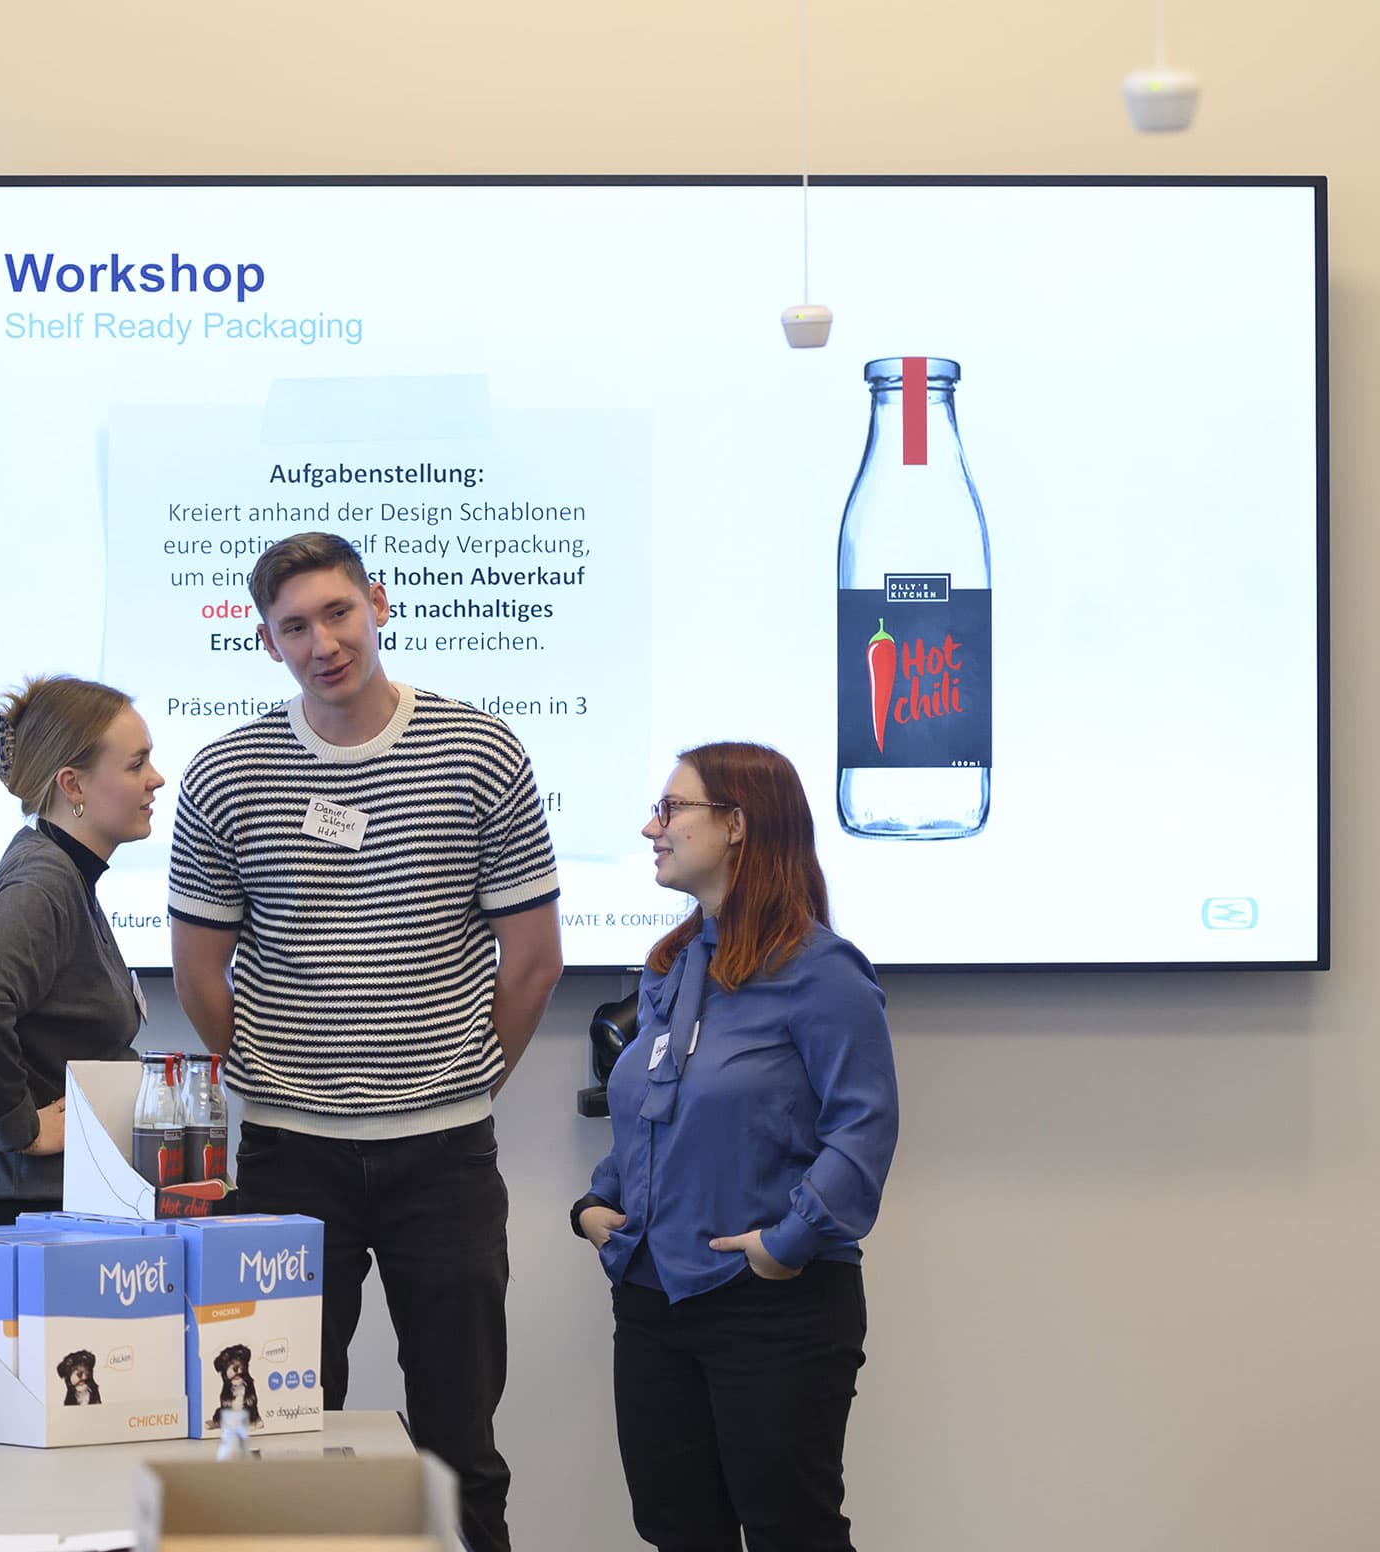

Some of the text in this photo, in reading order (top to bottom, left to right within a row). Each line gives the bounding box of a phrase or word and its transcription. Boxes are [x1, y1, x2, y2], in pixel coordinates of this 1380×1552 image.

[5, 253, 265, 302] Workshop
[5, 312, 363, 344] Shelf Ready Packaging
[270, 463, 484, 487] Aufgabenstellung:
[169, 502, 585, 525] Kreiert anhand der Design Schablonen
[164, 540, 212, 554] eure
[385, 534, 450, 558] Ready
[457, 534, 590, 558] Verpackung,
[171, 572, 204, 586] um
[395, 567, 463, 585] hohen
[471, 567, 585, 585] Abverkauf
[891, 591, 937, 599] KITCHEN
[201, 600, 252, 618] oder
[415, 599, 553, 622] nachhaltiges
[404, 636, 427, 650] zu
[435, 632, 545, 650] erreichen.
[902, 634, 962, 680] Hot
[483, 696, 541, 715] Ideen
[550, 697, 567, 714] in
[576, 697, 587, 714] 3
[894, 671, 964, 724] chili
[314, 802, 347, 819] Daniel
[111, 912, 161, 928] future
[561, 914, 603, 926] IVATE
[605, 914, 616, 926] &
[160, 1197, 181, 1216] Hot
[128, 1413, 179, 1428] CHICKEN
